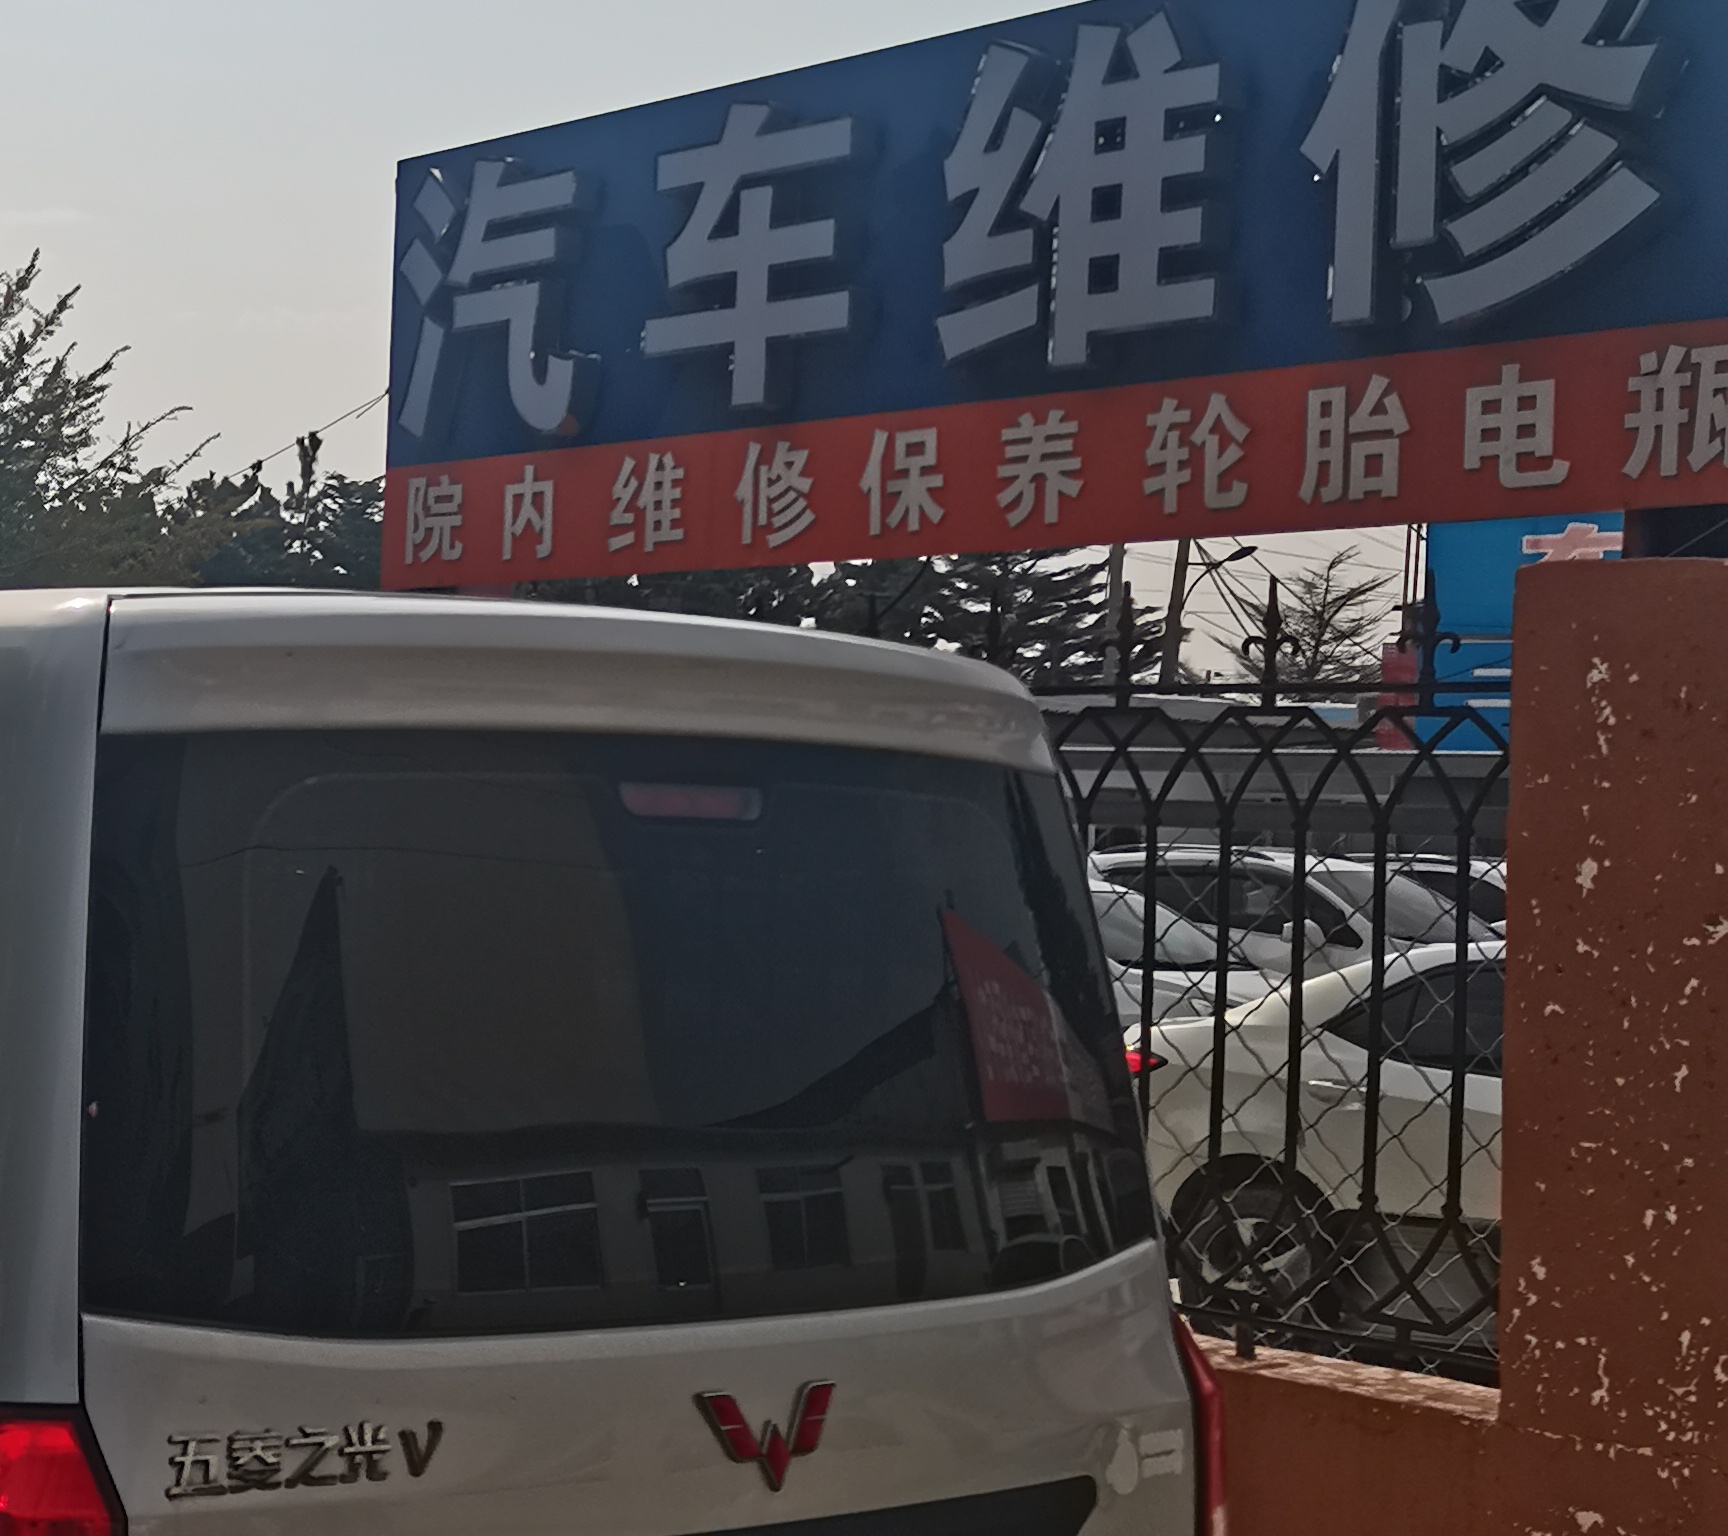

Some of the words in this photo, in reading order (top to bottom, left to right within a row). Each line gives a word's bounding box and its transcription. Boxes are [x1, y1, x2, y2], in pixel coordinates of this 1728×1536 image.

[403, 342, 1728, 567] 院内维修保养轮胎电瓶
